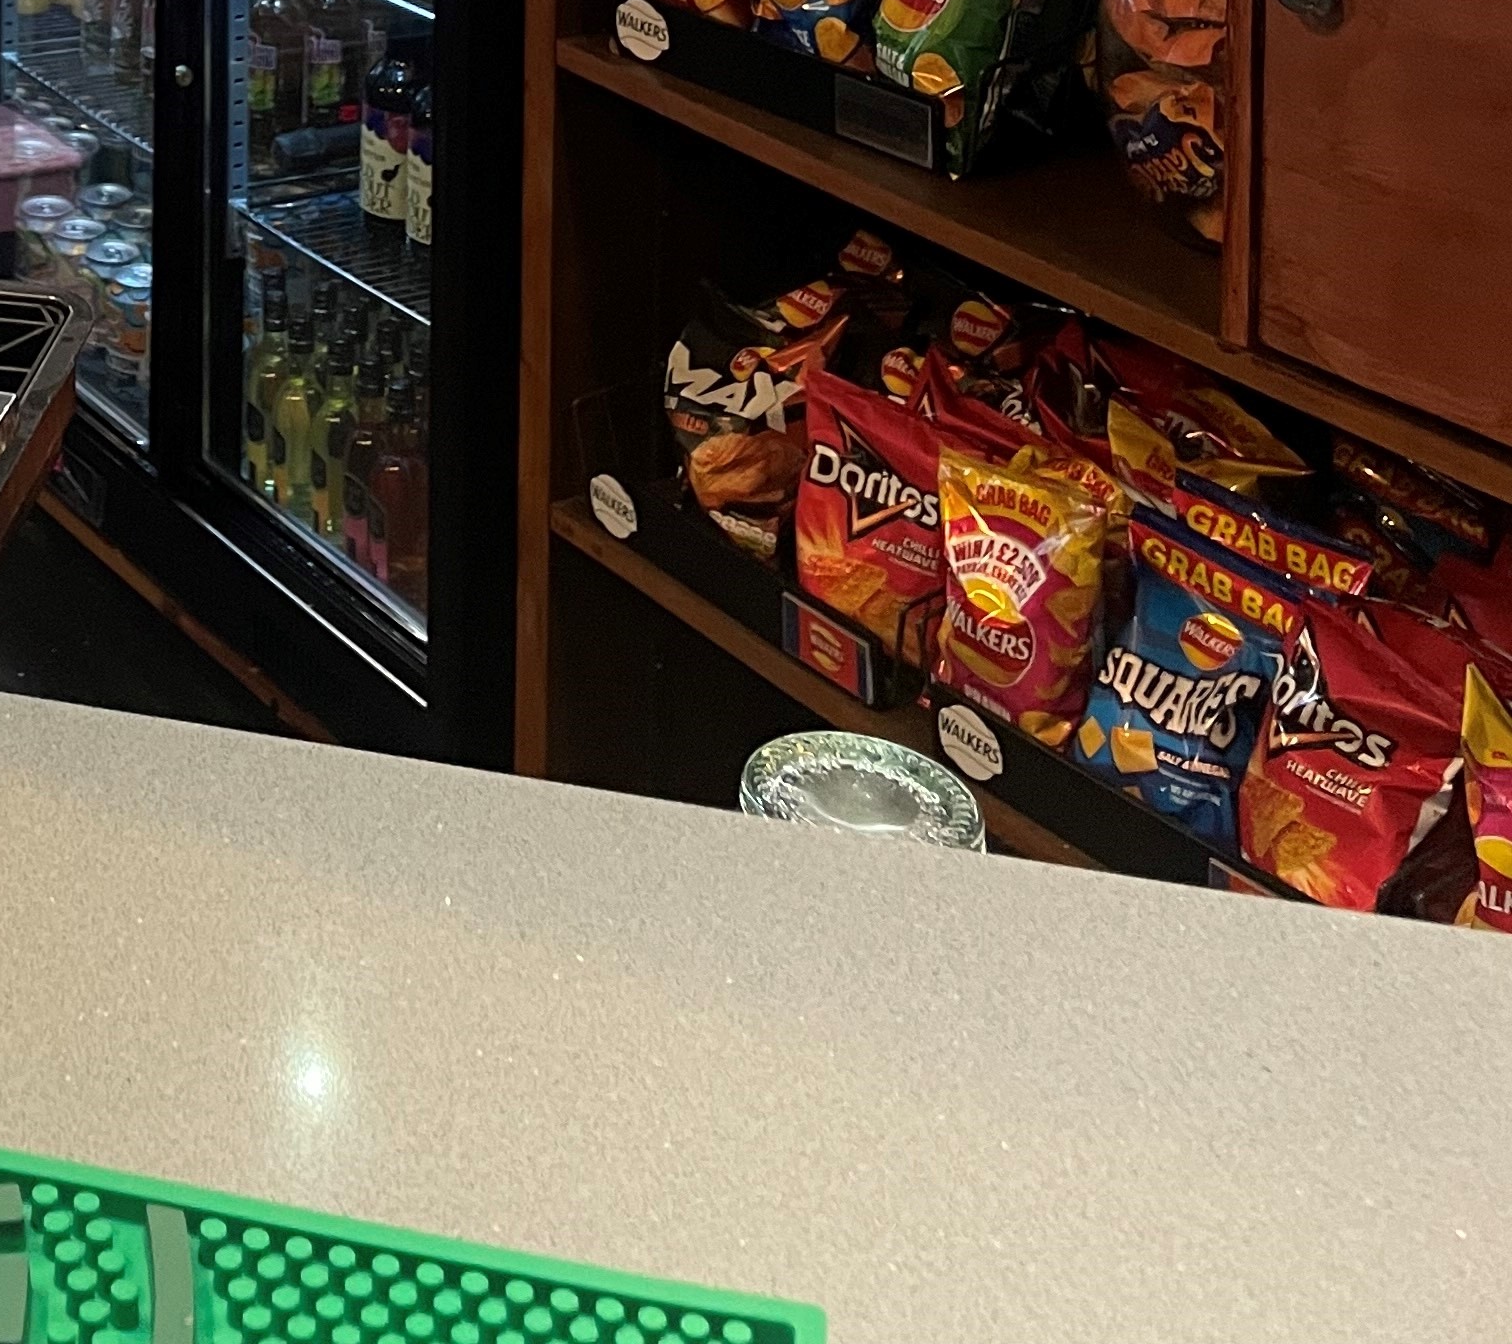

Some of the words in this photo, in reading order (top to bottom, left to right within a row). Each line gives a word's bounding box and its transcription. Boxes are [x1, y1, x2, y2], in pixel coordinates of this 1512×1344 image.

[617, 8, 667, 44] WALKERS
[666, 340, 805, 434] MAX
[810, 443, 940, 528] Doritos
[976, 482, 1018, 511] GRAB
[1018, 490, 1052, 524] BAG
[871, 538, 940, 569] HEATWAVE
[1188, 504, 1278, 562] GRAB
[1286, 542, 1354, 594] BAG
[1141, 537, 1231, 605] GRAB
[1240, 589, 1293, 633] BA
[949, 599, 1032, 662] WALKERS
[1184, 620, 1237, 660] WALKERS
[1098, 647, 1261, 750] SQUARES
[938, 711, 1003, 765] WALKERS
[1286, 758, 1370, 808] HEATWAVE
